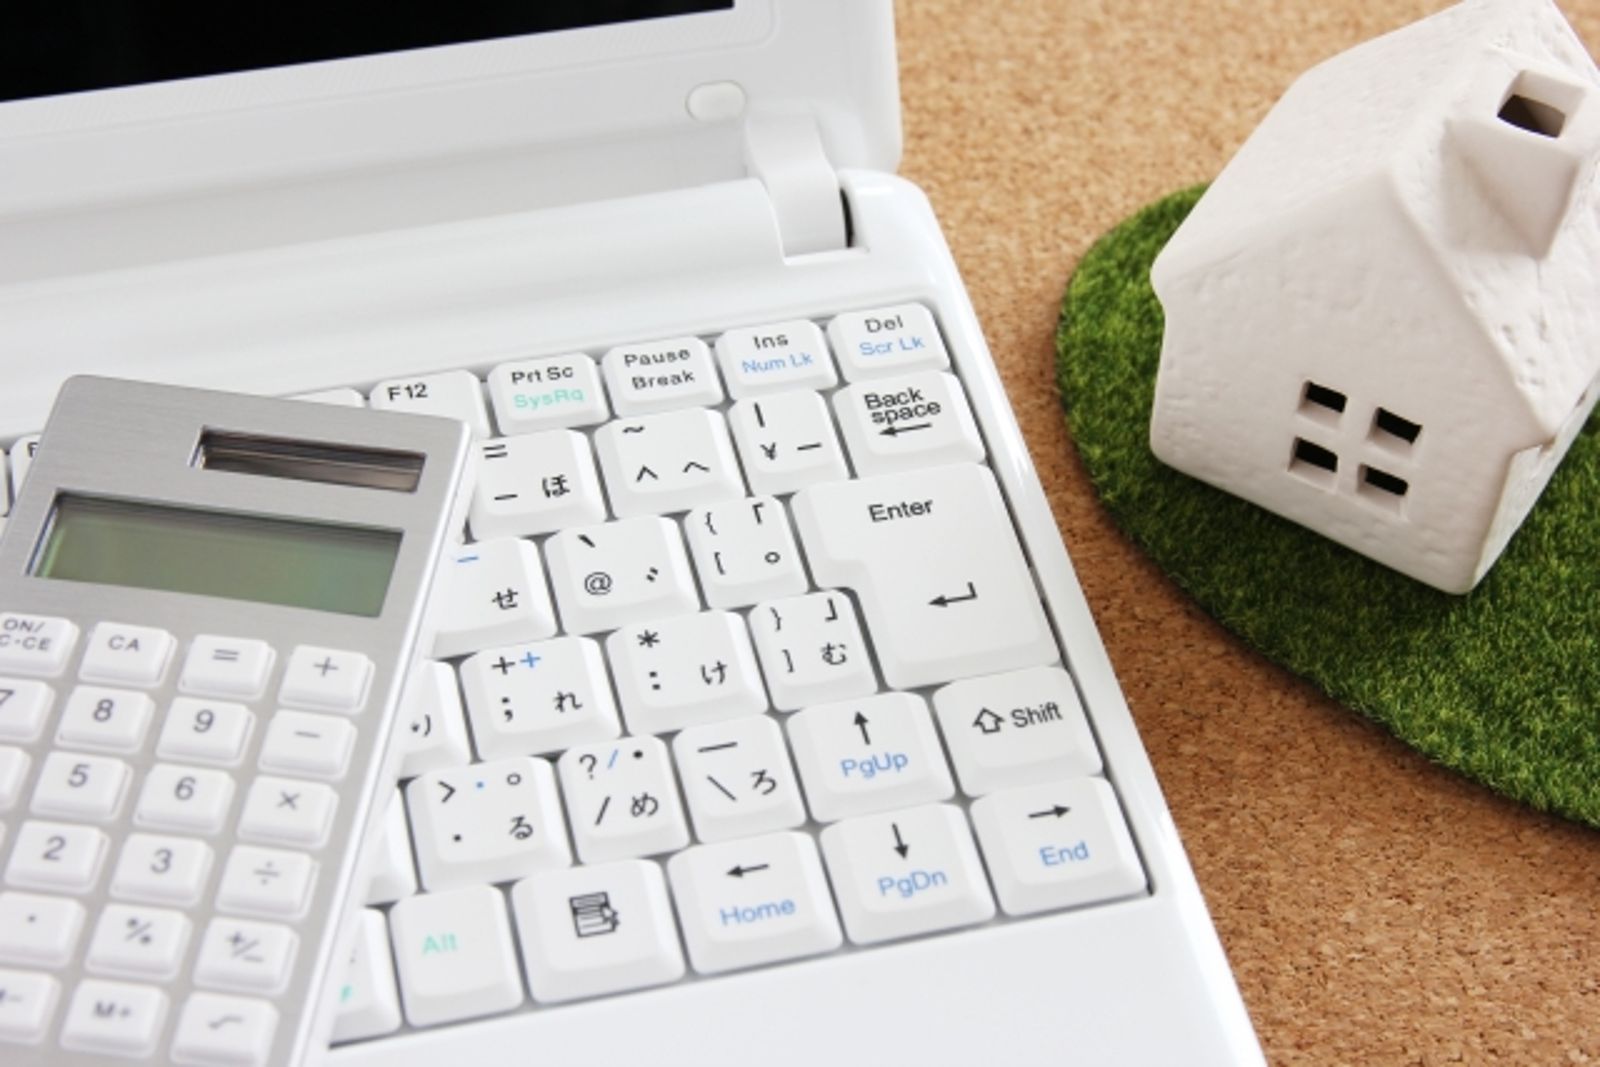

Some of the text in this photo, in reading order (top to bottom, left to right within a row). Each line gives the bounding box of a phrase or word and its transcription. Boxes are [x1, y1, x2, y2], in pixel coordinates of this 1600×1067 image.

[864, 316, 904, 334] Del
[753, 334, 789, 350] Ins
[858, 335, 926, 357] Scr Lk
[623, 348, 691, 368] Pause
[741, 352, 815, 375] Num Lk
[510, 365, 574, 385] Prt Sc
[631, 369, 696, 390] Break
[386, 382, 430, 402] F12
[512, 387, 585, 410] SysRq
[863, 387, 925, 411] Back
[870, 402, 942, 427] space
[759, 442, 777, 461] ¥
[541, 474, 571, 499] ほ
[867, 499, 934, 523] Enter
[584, 571, 613, 596] @
[491, 587, 519, 611] せ
[107, 636, 141, 652] CA
[819, 642, 848, 667] む
[700, 660, 728, 686] け
[92, 698, 114, 723] 8
[553, 690, 584, 714] れ
[191, 709, 215, 734] 9
[1010, 702, 1064, 729] Shift
[67, 763, 91, 789] 5
[579, 754, 598, 780] ?
[839, 751, 910, 780] PgUp
[173, 776, 197, 801] 6
[751, 768, 779, 797] ろ
[630, 792, 660, 818] め
[509, 815, 535, 842] る
[41, 836, 67, 862] 2
[150, 849, 173, 874] 3
[1038, 840, 1090, 868] End
[876, 869, 948, 899] PgDn
[718, 897, 797, 928] Home
[421, 933, 457, 956] Alt
[92, 1000, 133, 1020] M+
